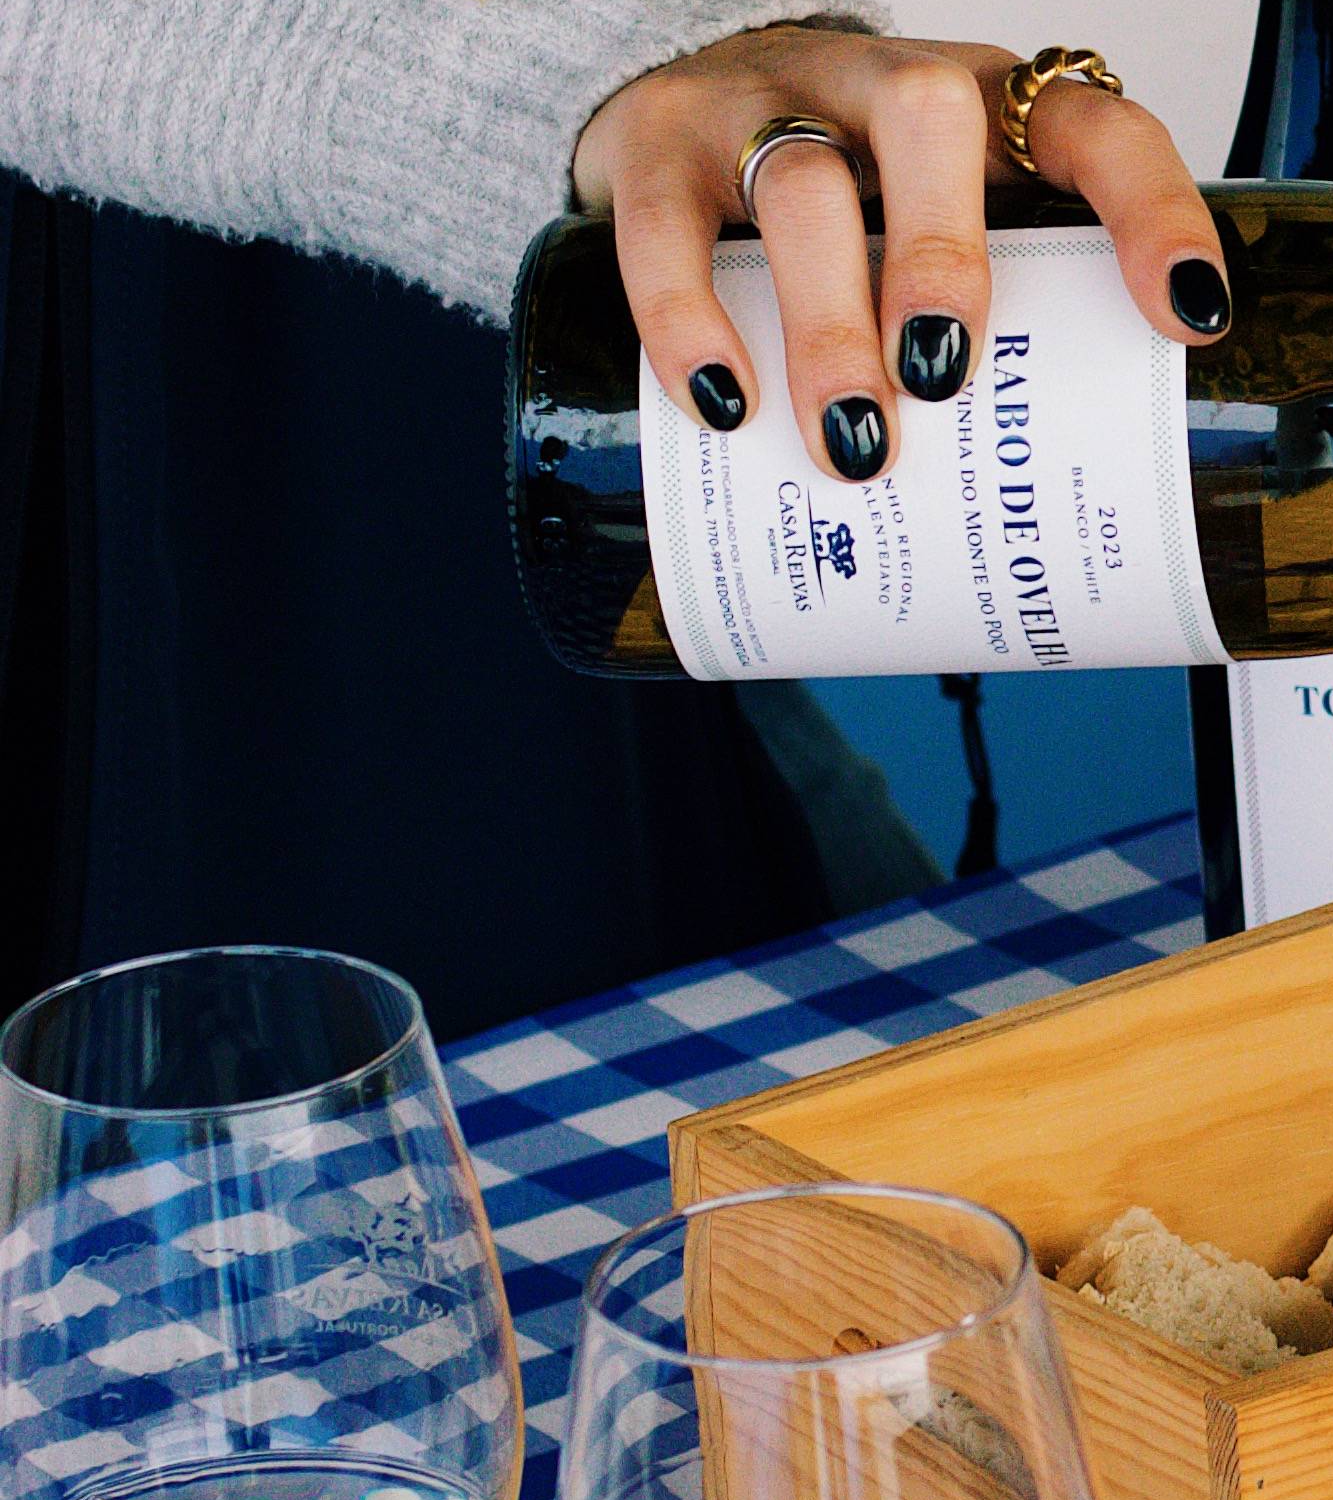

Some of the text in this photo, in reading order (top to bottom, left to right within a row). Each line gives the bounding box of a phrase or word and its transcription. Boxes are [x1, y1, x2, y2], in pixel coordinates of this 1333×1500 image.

[705, 518, 724, 573] 7170-999
[766, 527, 781, 577] PORTUGAL
[777, 480, 813, 614] CASA RELVAS
[861, 485, 891, 606] ALENTEJANO
[881, 477, 914, 625] NHO REGIONAL
[956, 379, 1011, 656] VINHA DO MONTE DO POÇO
[992, 331, 1074, 667] RABO DE OVELHA
[1070, 465, 1091, 540] BRANCO
[1081, 554, 1103, 605] WHITE
[1098, 506, 1124, 570] 2023
